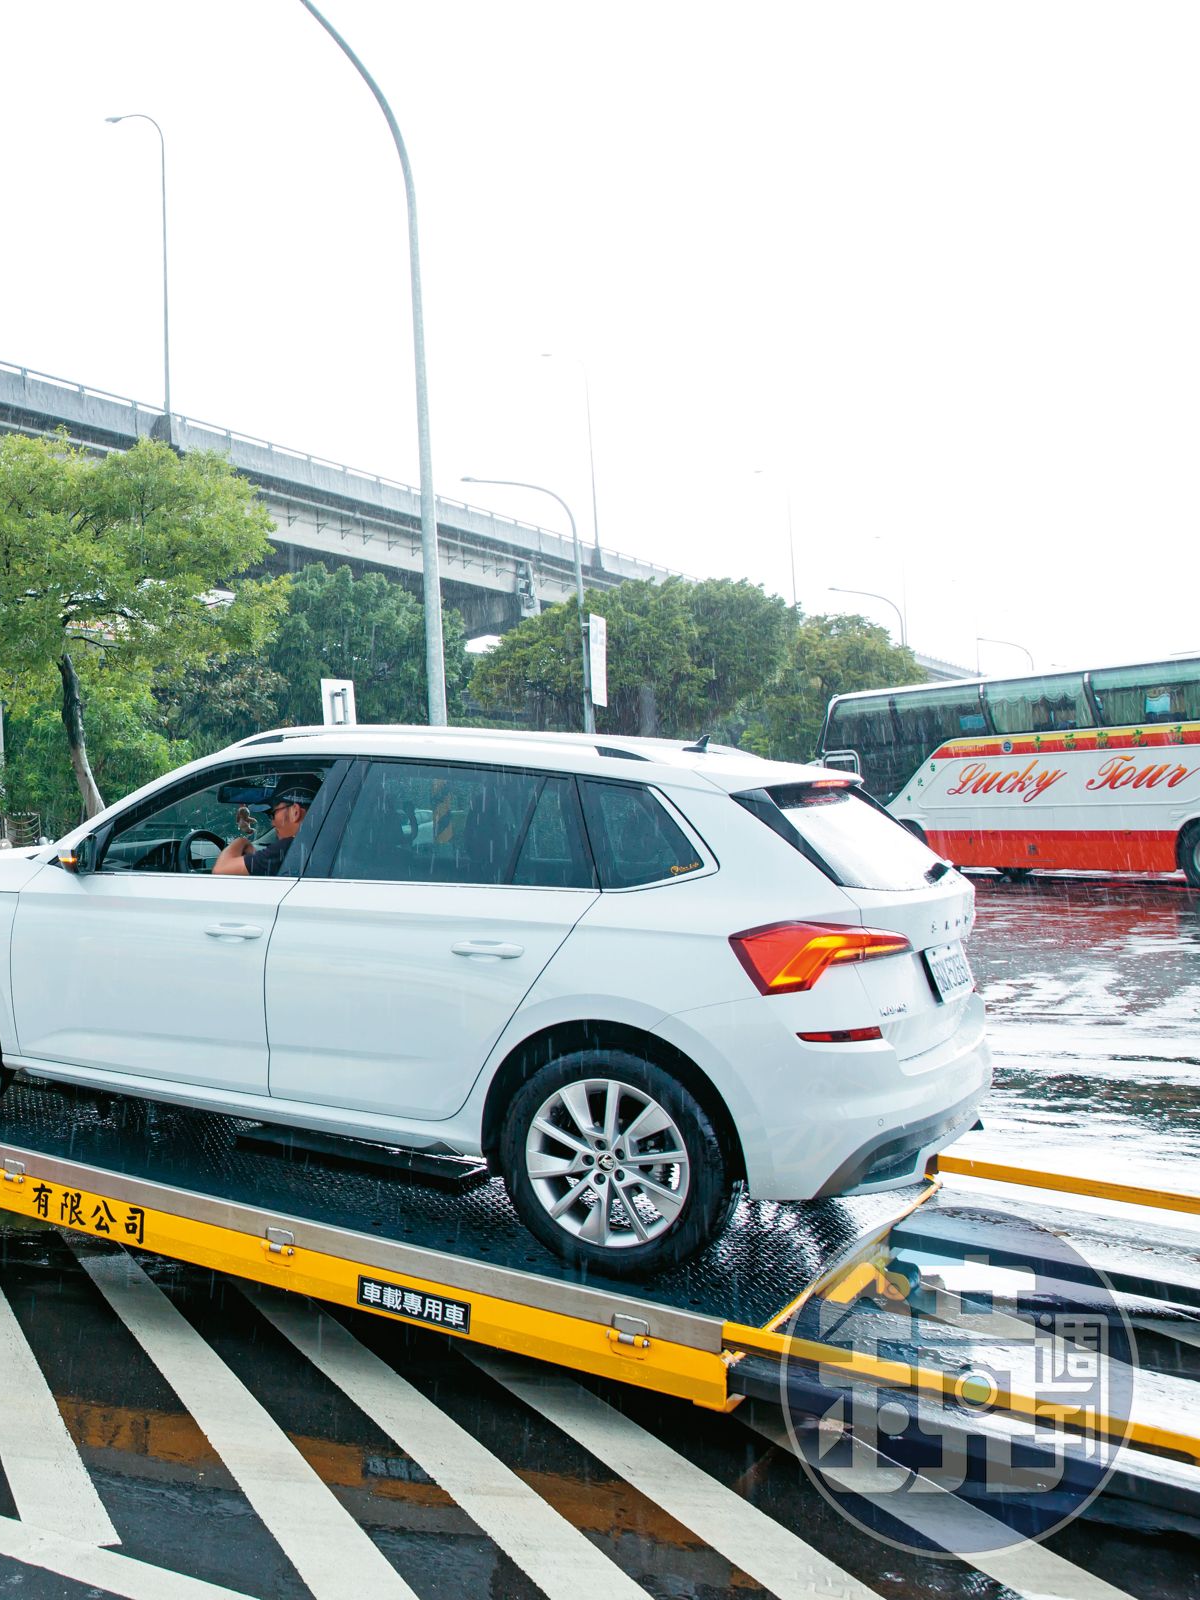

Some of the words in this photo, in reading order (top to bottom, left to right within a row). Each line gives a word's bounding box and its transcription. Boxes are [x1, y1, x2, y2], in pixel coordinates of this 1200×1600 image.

[946, 759, 1068, 803] Lucky
[1086, 755, 1200, 791] Tour
[32, 1183, 147, 1246] 有限公司
[362, 1281, 466, 1326] 車載專用車
